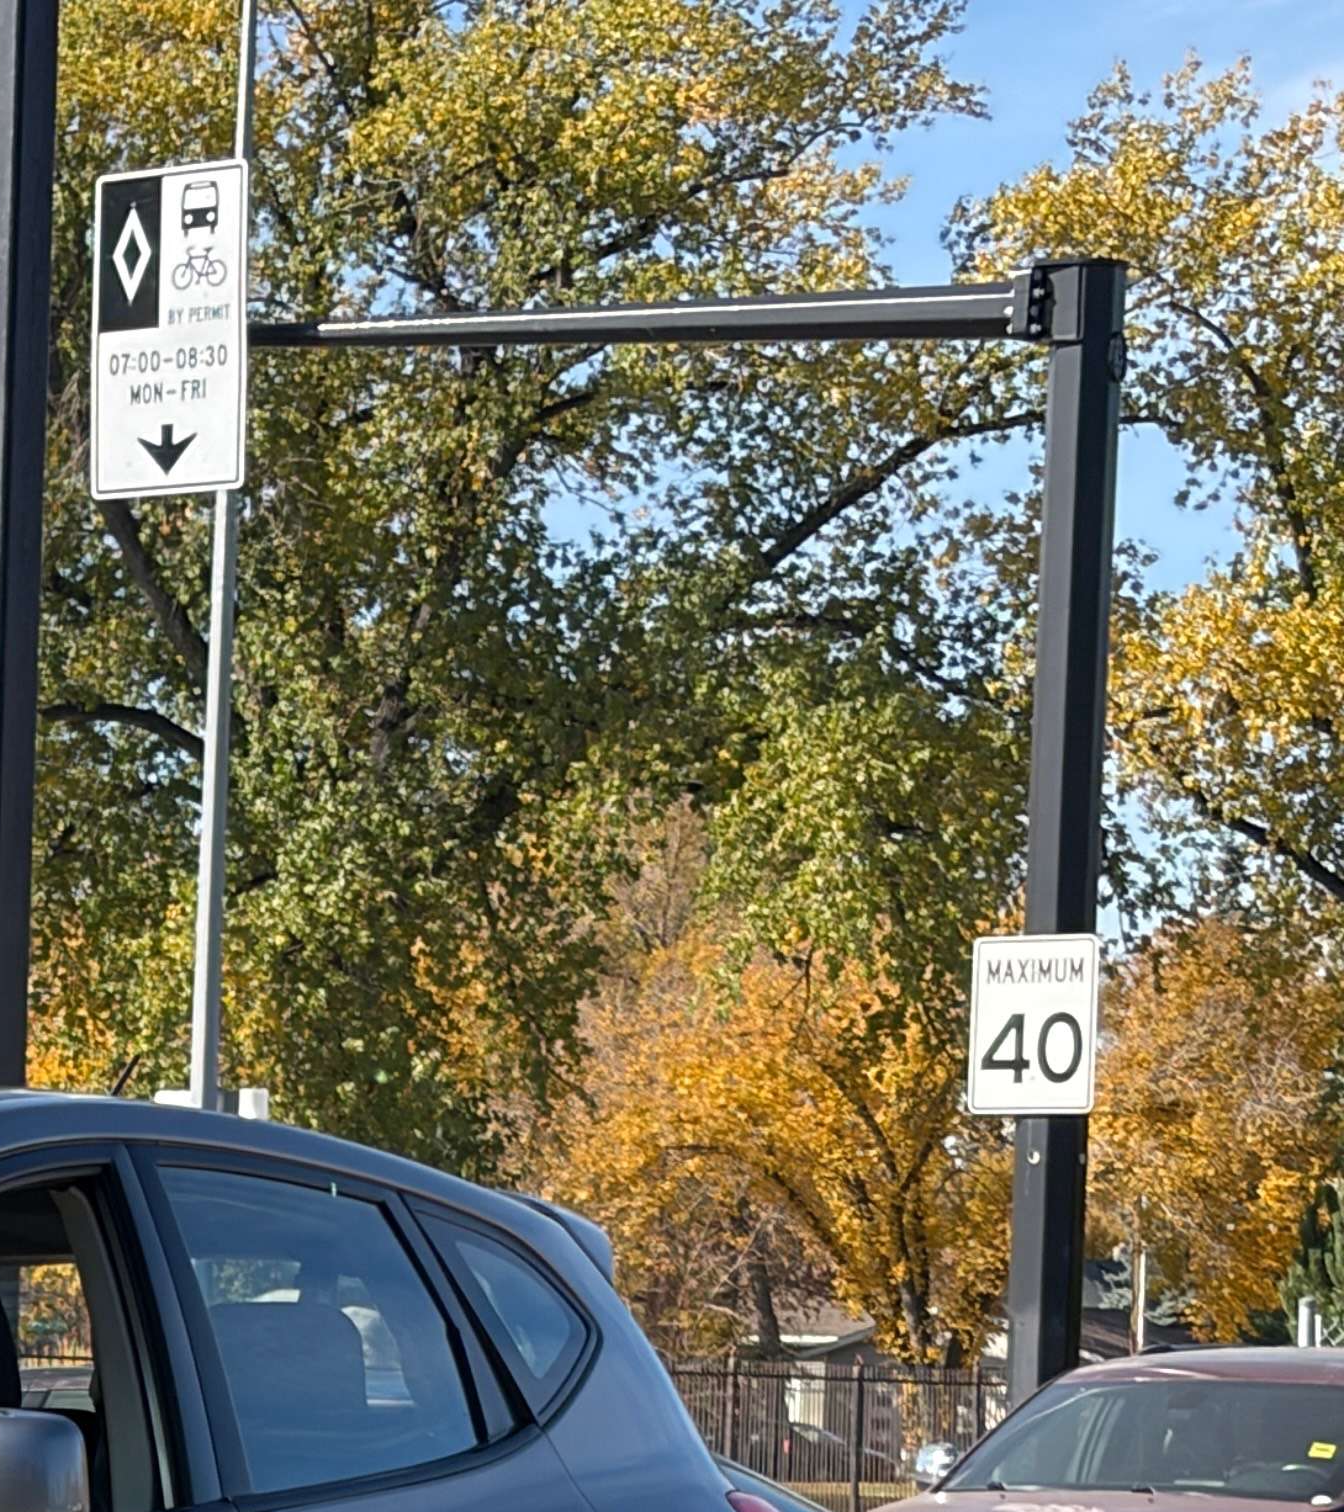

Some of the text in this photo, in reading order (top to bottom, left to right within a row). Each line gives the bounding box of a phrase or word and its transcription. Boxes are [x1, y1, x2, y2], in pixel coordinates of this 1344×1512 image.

[167, 303, 231, 326] BY PERMIT
[109, 343, 228, 376] 07:00-08:30
[985, 956, 1085, 985] MAXIMUM
[980, 1011, 1084, 1084] 40
